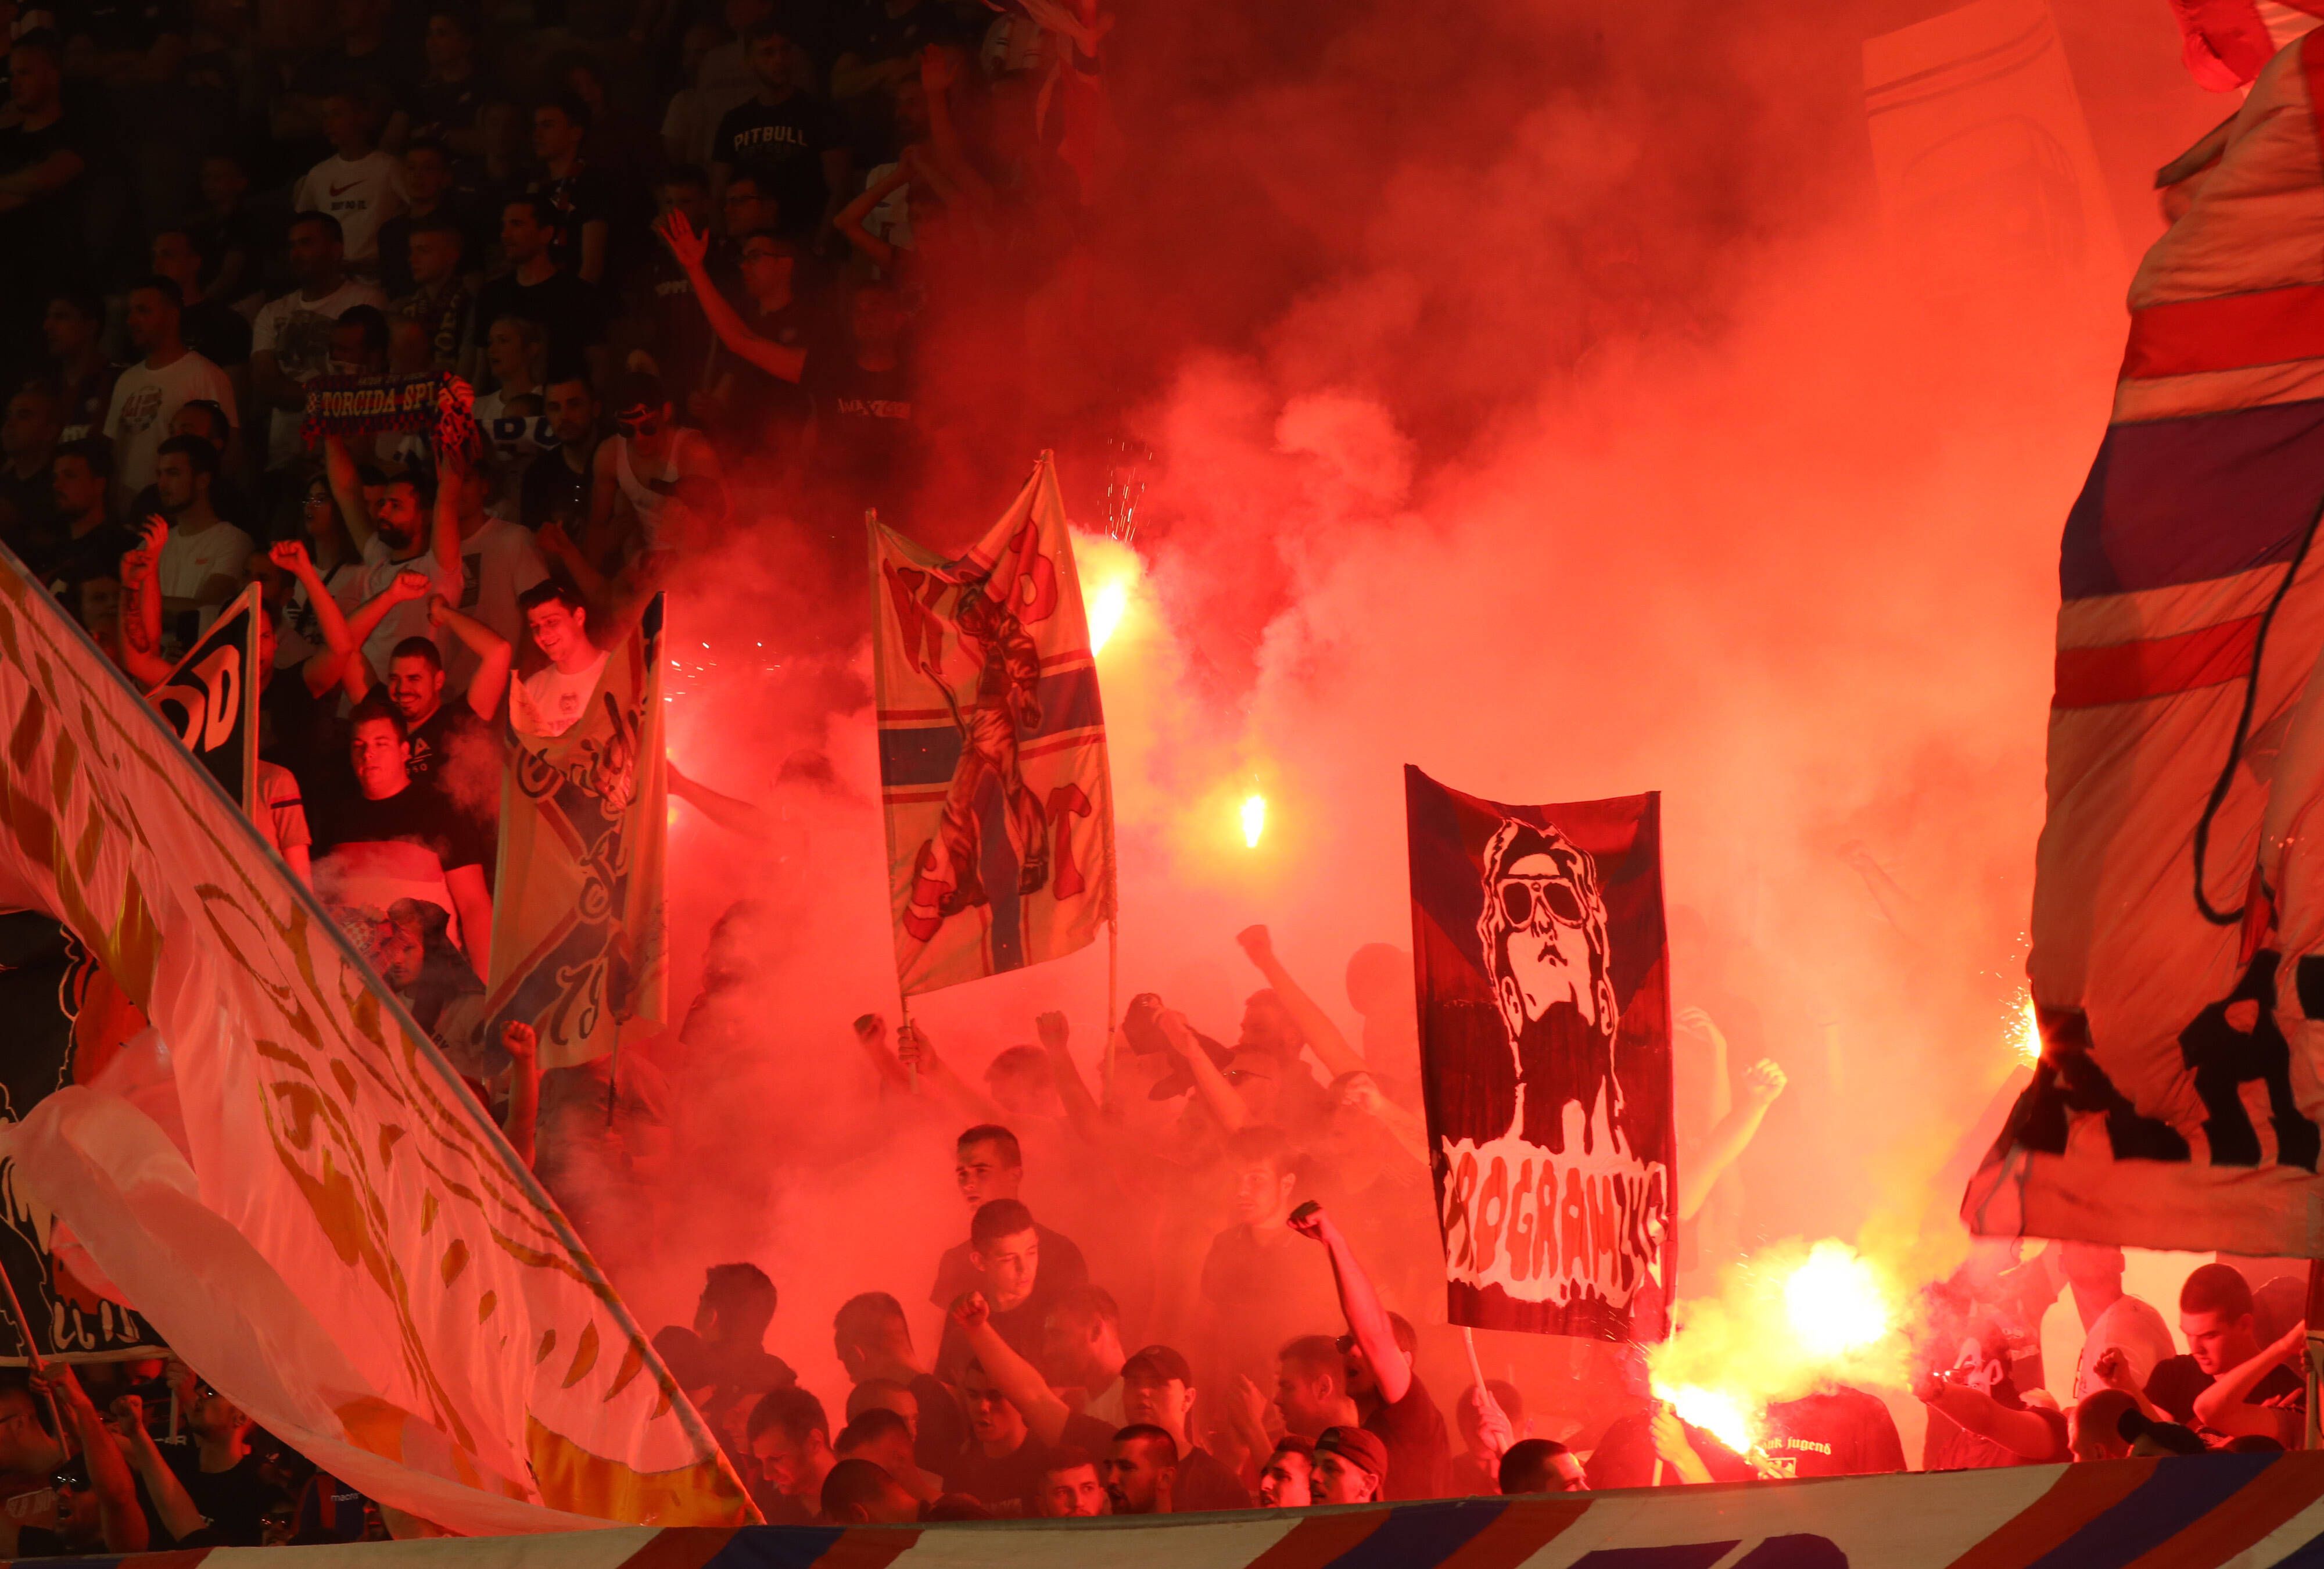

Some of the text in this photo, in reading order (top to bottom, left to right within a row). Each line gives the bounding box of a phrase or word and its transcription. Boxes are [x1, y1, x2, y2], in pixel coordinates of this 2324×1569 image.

[734, 125, 809, 152] PITBULL
[322, 381, 440, 417] TORCIDA SPL
[1785, 1436, 1832, 1456] jugend
[330, 1492, 361, 1502] macro
